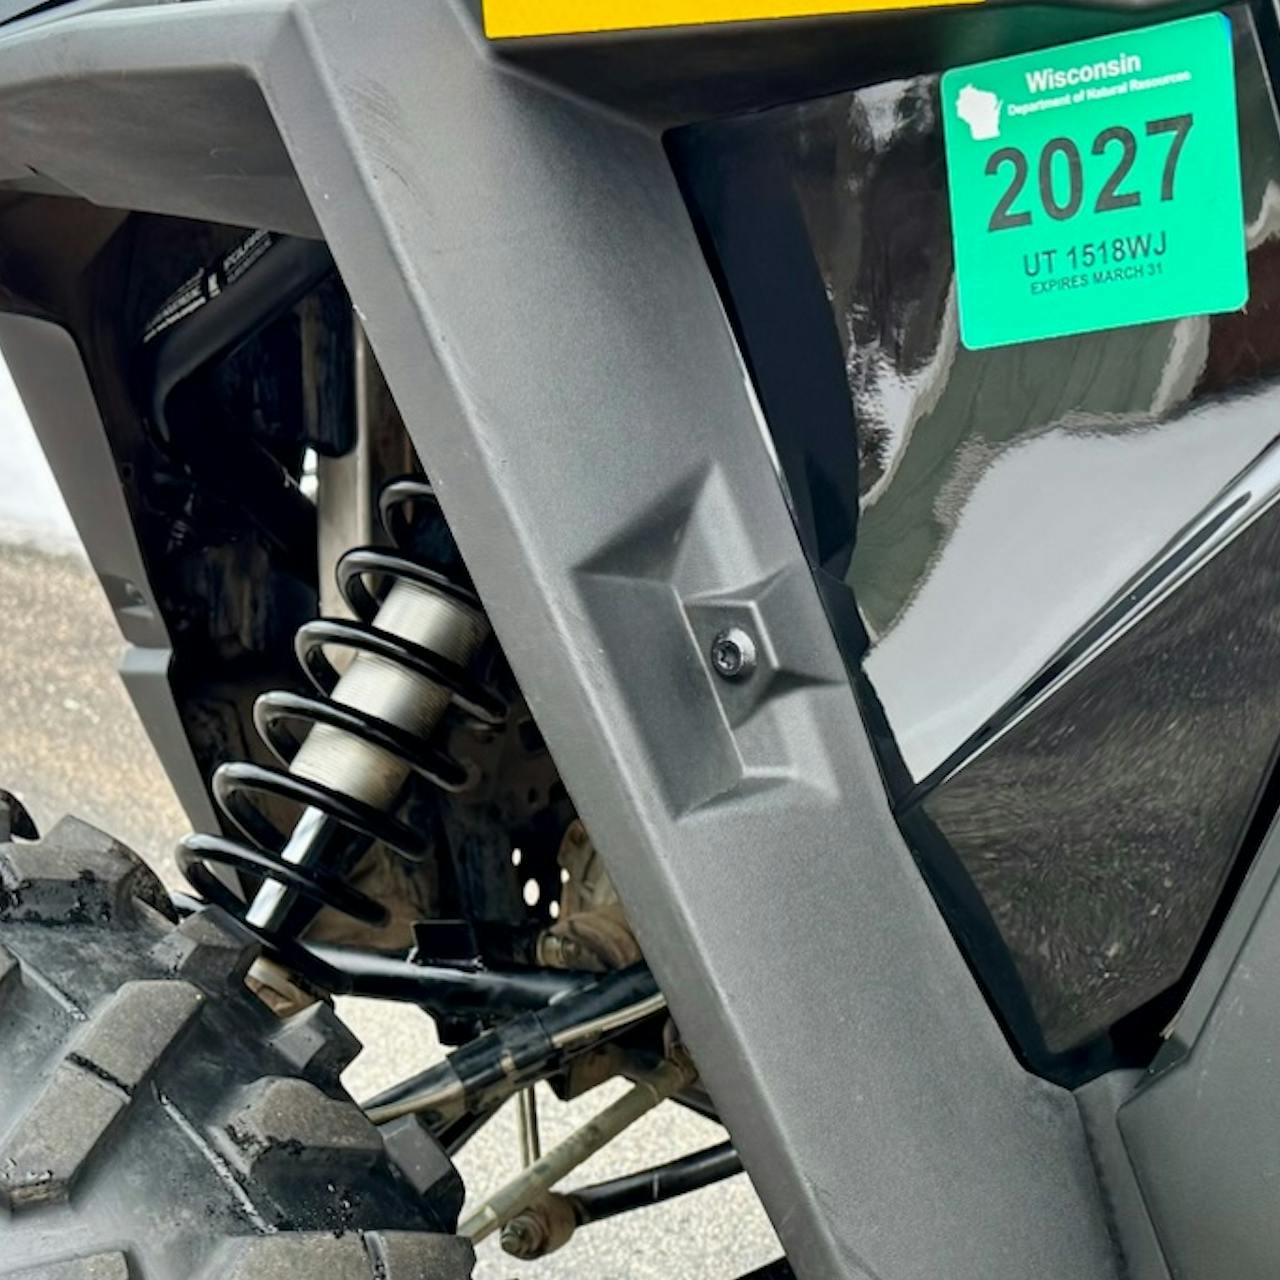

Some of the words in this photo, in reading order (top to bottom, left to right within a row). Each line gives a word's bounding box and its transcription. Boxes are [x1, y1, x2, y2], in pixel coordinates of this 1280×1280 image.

[1007, 94, 1072, 116] Department
[1073, 89, 1085, 102] of
[1086, 82, 1128, 100] Natural
[1129, 70, 1192, 92] Resources
[1025, 53, 1142, 94] Wisconsin
[984, 113, 1194, 233] 2027
[1023, 249, 1058, 277] UT
[1066, 231, 1167, 269] 1518WJ
[1030, 274, 1089, 295] EXPIRES
[1092, 265, 1144, 284] MARCH
[1147, 262, 1163, 276] 31
